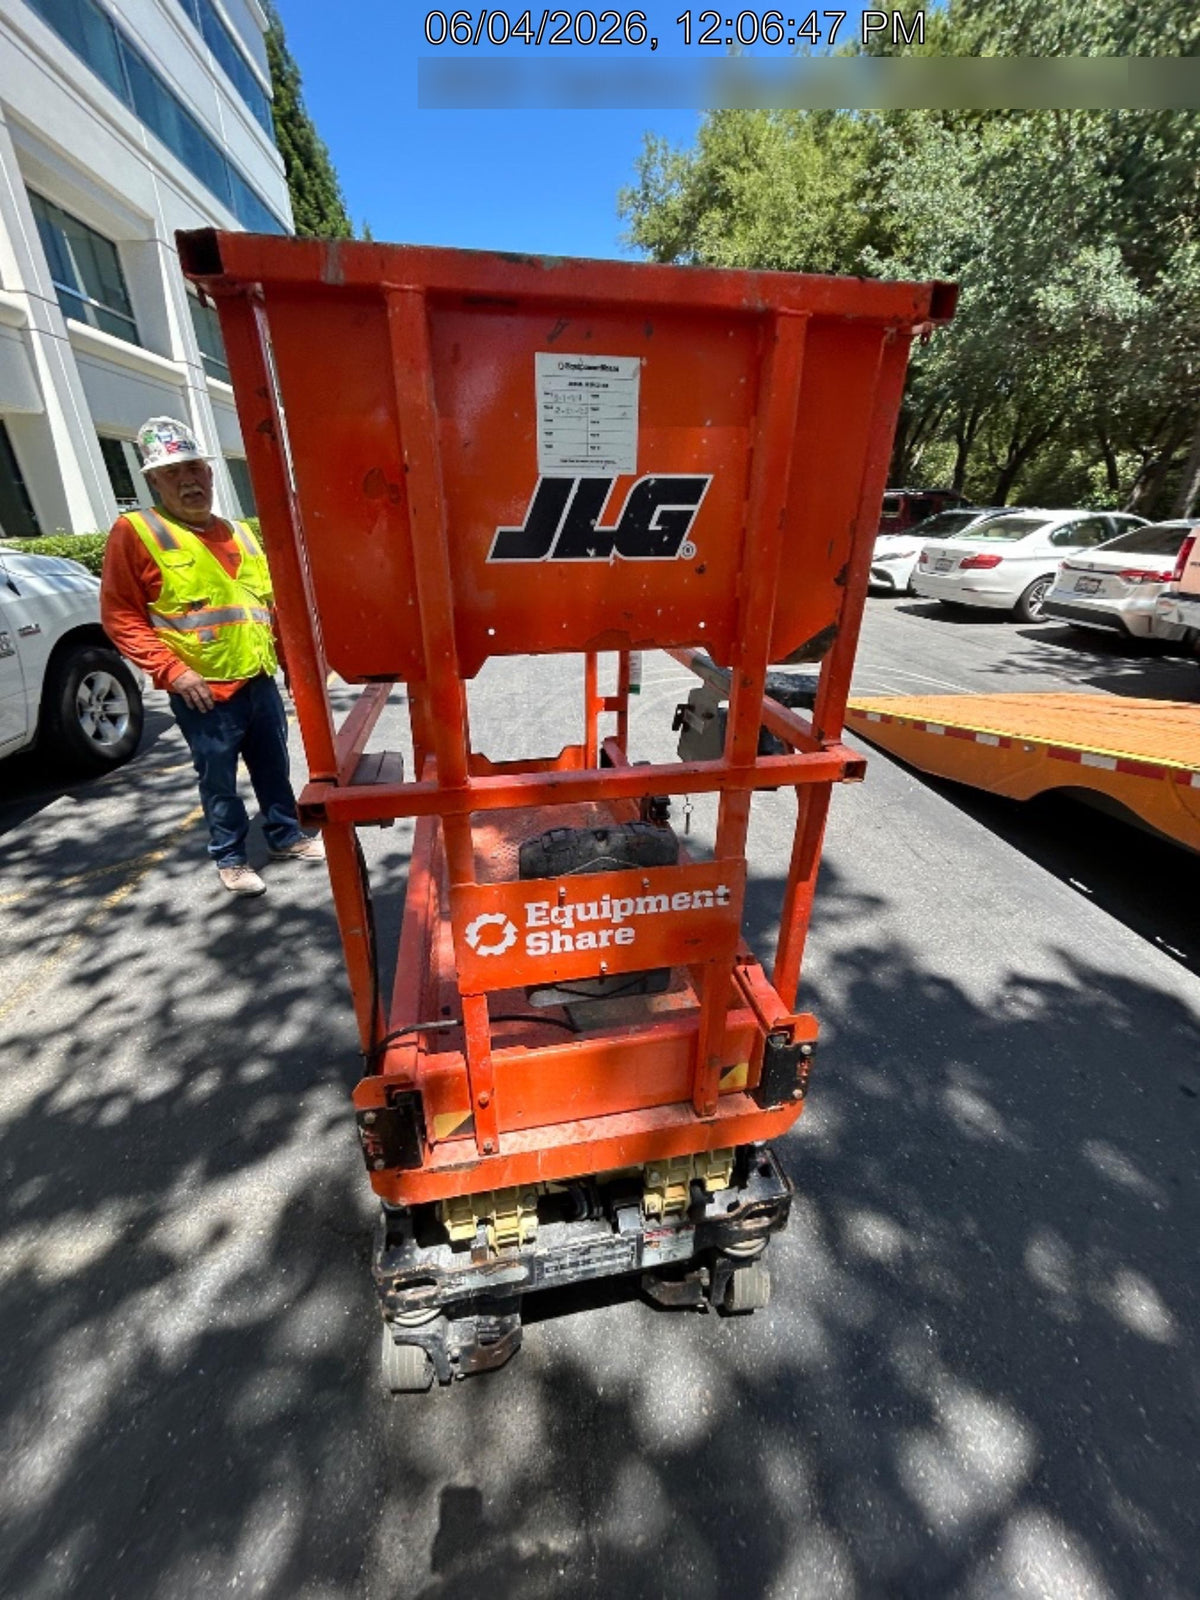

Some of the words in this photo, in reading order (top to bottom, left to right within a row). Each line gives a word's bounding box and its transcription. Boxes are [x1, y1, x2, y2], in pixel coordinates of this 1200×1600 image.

[485, 474, 714, 563] JLG
[524, 884, 731, 929] Equipment
[525, 926, 636, 957] Share
